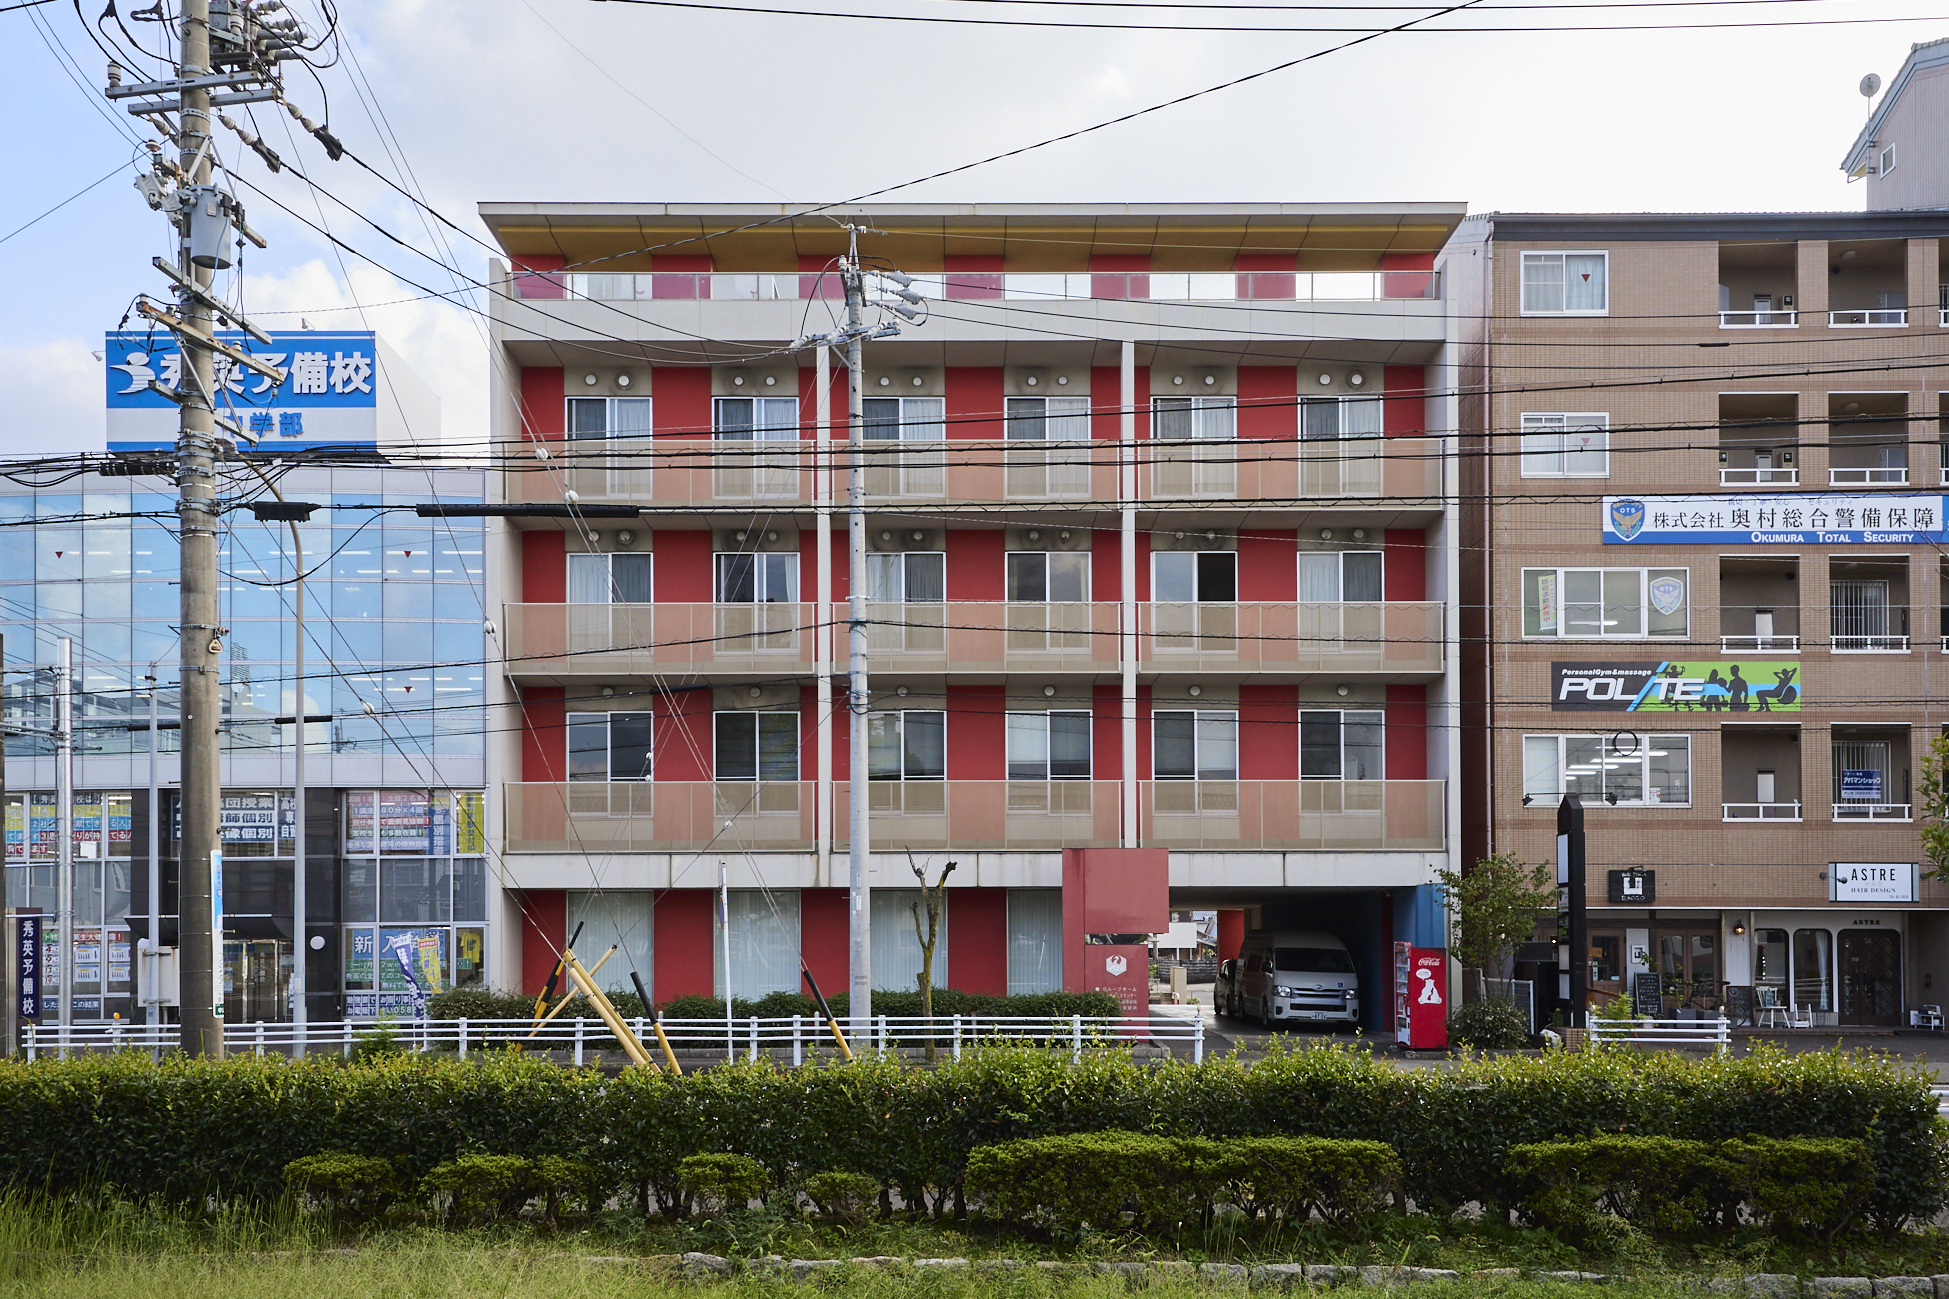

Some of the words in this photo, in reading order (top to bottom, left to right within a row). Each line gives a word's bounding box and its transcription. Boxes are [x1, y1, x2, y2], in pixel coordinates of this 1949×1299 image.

[1750, 531, 1804, 543] OKUMURA
[1816, 531, 1851, 543] TOTAL
[1863, 531, 1914, 543] SECURITY
[221, 797, 279, 809] 団授業
[221, 812, 278, 824] 師個別
[1851, 868, 1896, 881] ASTRE
[22, 920, 34, 1015] 秀英予備校
